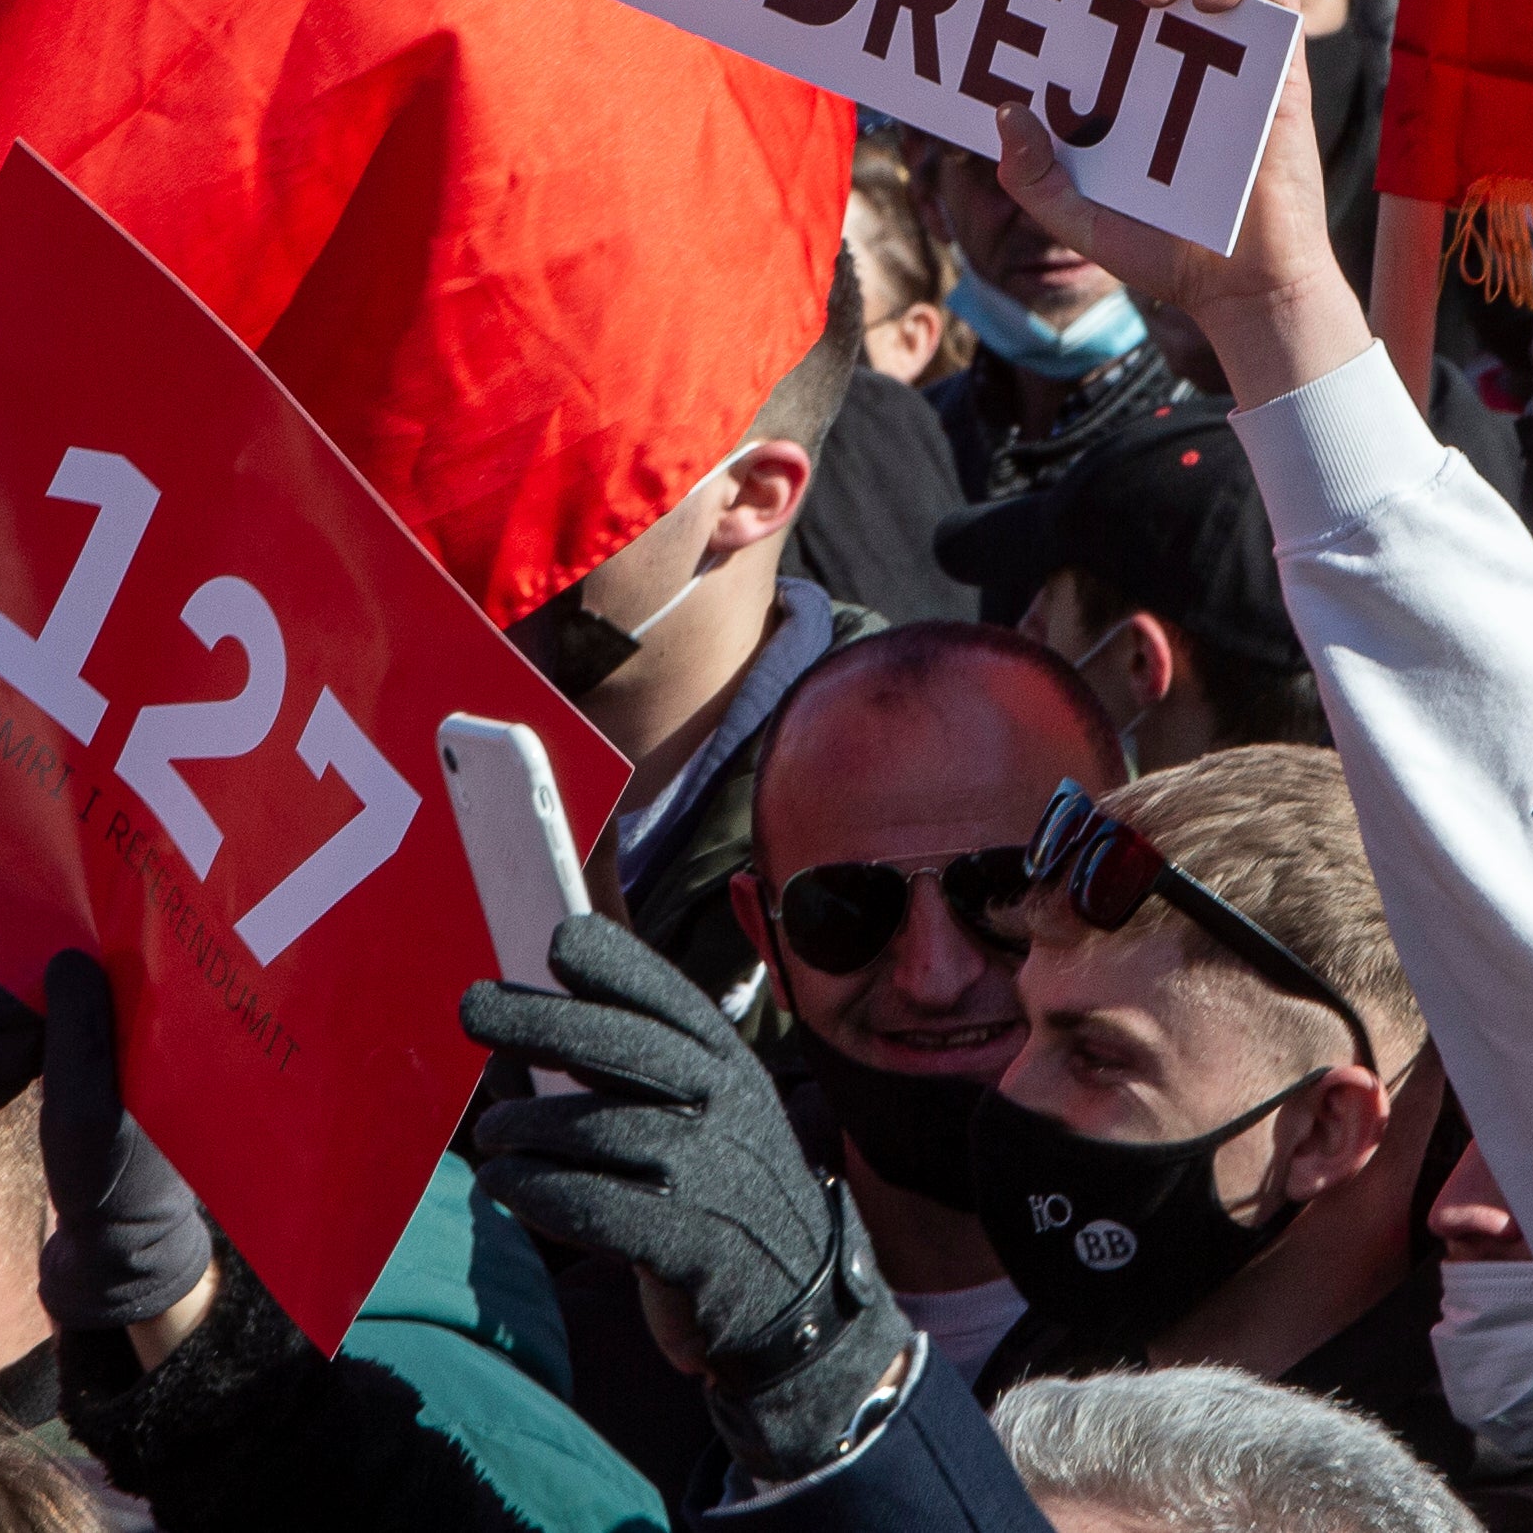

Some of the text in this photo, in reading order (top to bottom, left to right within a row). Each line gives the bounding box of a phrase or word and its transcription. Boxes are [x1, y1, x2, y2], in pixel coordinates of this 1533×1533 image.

[77, 786, 101, 824] I
[105, 810, 301, 1073] REFERENDUMIT
[1080, 1229, 1132, 1263] BB
